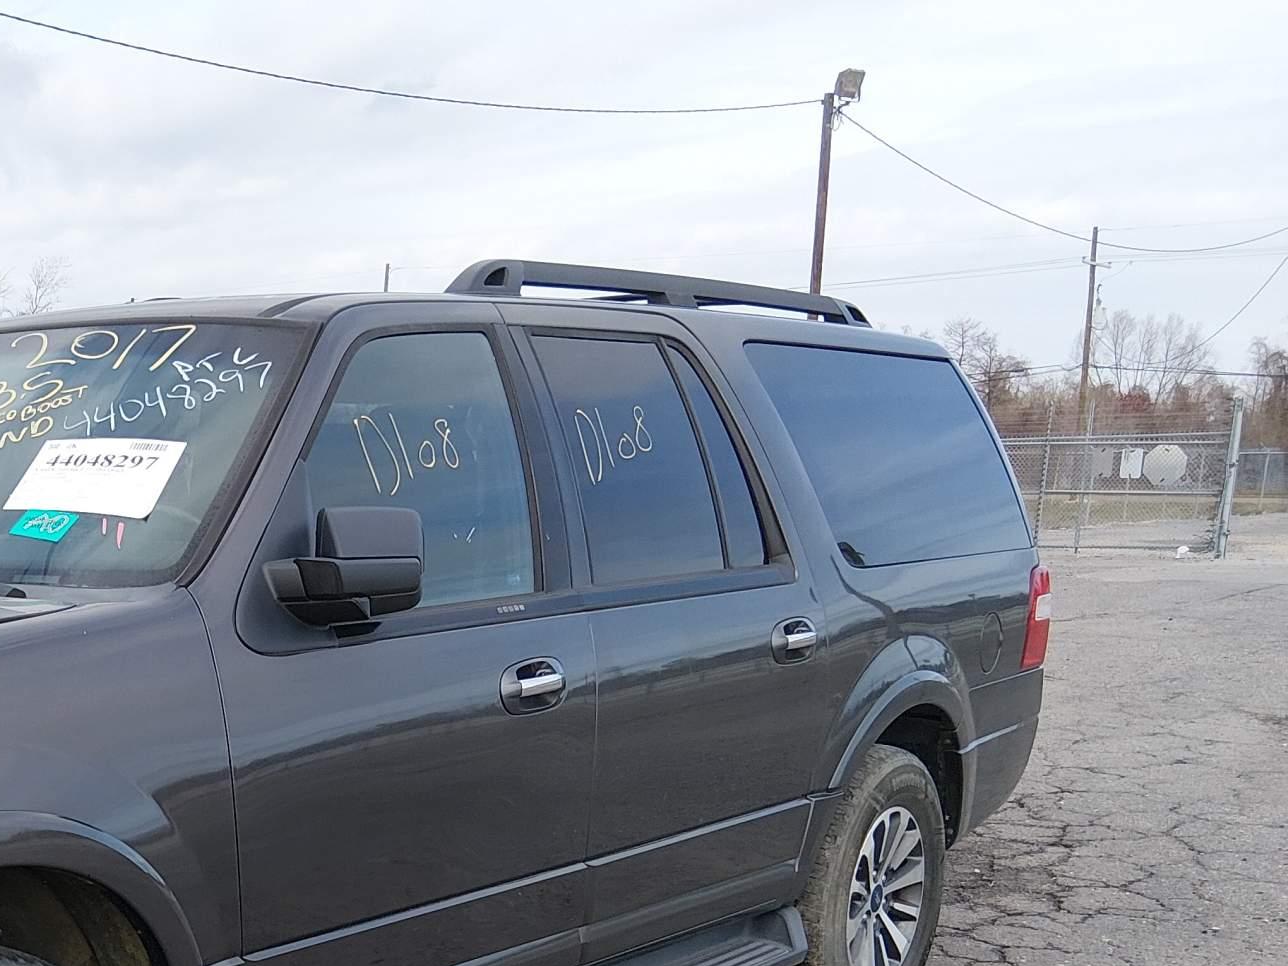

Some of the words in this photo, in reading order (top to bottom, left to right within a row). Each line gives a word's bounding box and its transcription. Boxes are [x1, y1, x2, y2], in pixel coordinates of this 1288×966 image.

[10, 324, 197, 372] 2017
[63, 360, 273, 437] 44048297
[46, 453, 160, 471] 44048297
